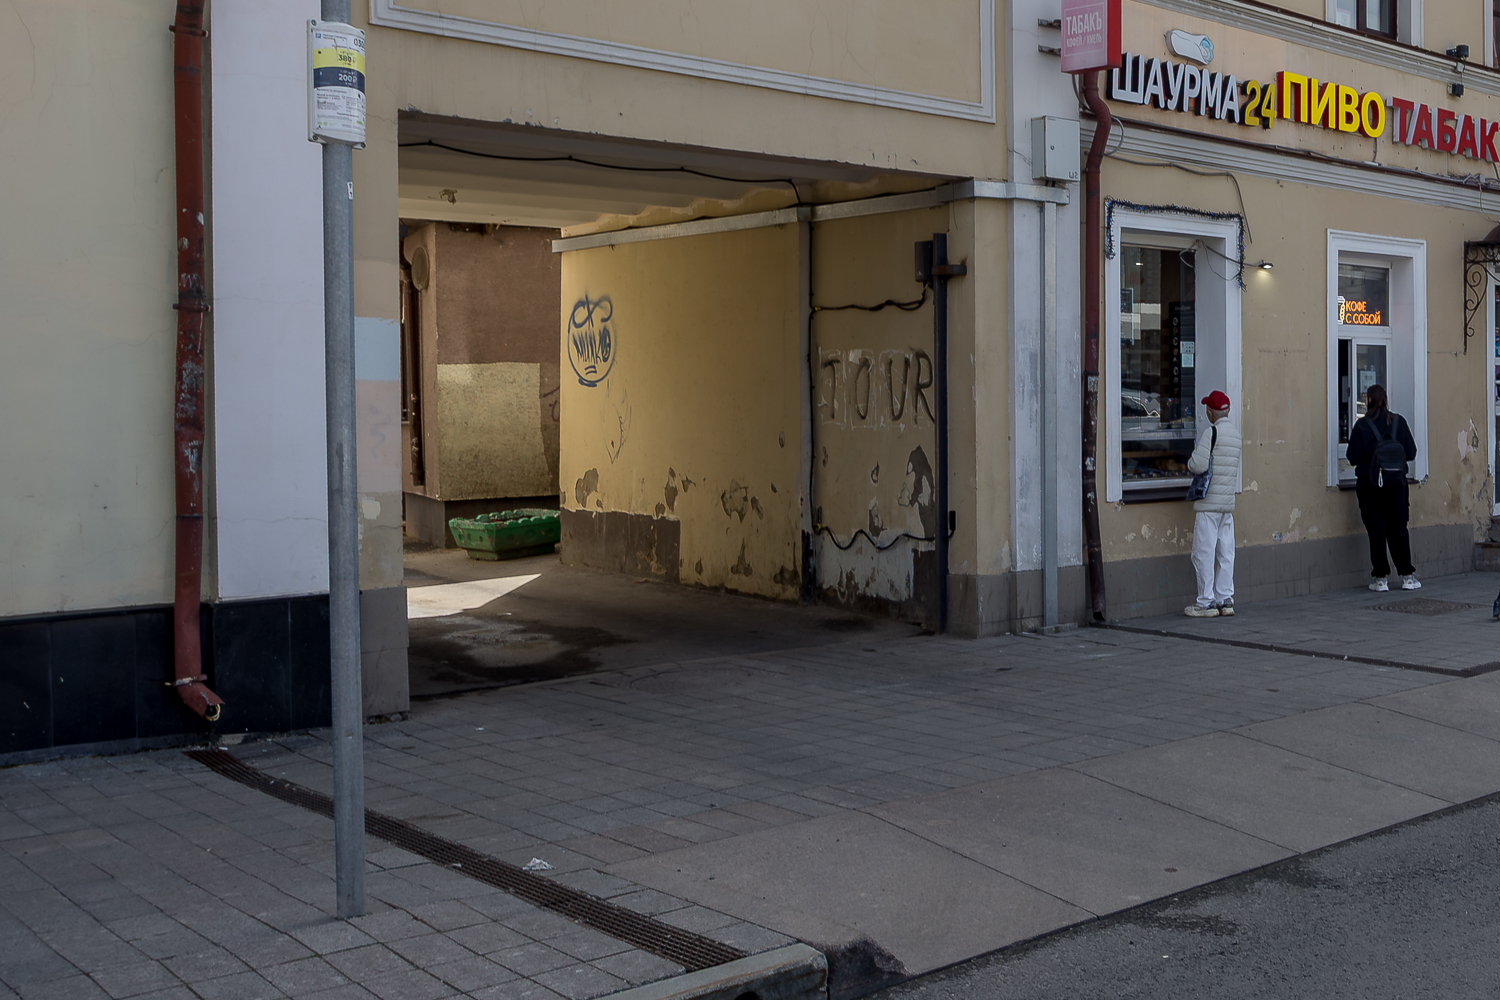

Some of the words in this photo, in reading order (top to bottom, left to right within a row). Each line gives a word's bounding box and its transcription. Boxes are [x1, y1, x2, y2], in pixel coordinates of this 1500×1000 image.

[1066, 11, 1102, 36] ТАБАКЪ
[1111, 51, 1240, 124] ШАУРМА
[1243, 79, 1278, 130] 24
[1279, 70, 1386, 138] ПИВО
[1389, 96, 1500, 163] ТАБАК
[1345, 300, 1367, 312] КОФЕ
[1345, 313, 1352, 324] С
[1352, 310, 1381, 325] СОБОЙ
